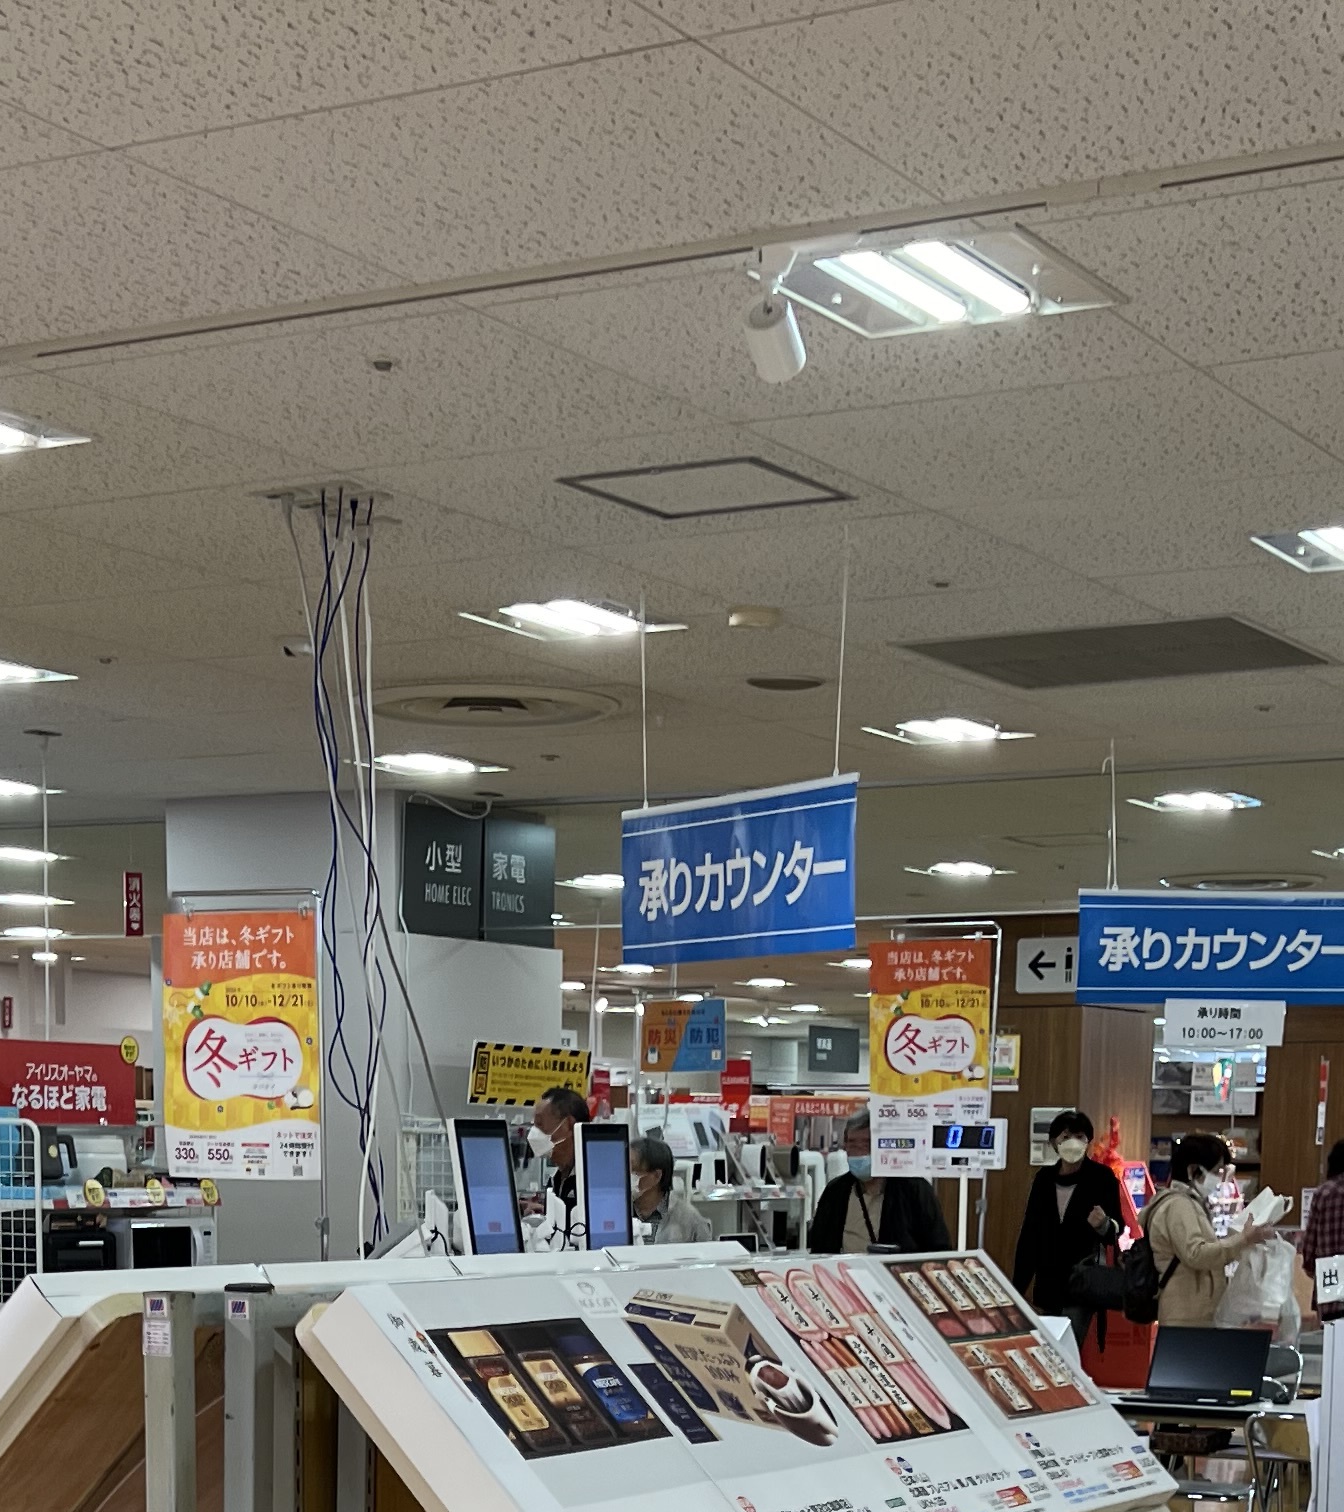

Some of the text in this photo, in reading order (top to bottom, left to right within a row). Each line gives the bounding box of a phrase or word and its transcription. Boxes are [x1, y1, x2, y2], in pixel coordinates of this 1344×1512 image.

[425, 840, 463, 874] 小型
[492, 852, 526, 884] 家電
[638, 839, 846, 922] 承りカウンター
[424, 882, 472, 907] HOME ELEC
[492, 891, 525, 914] TRONICS
[183, 925, 294, 947] 当店は、冬ギフト
[191, 950, 287, 970] 承り店舗です。
[887, 949, 975, 966] 当店は、冬ギフト
[894, 966, 967, 982] 承り店舗です。
[1196, 1006, 1242, 1020] 承り時間
[647, 1027, 677, 1046] 防災
[689, 1026, 721, 1046] 防犯
[11, 1084, 107, 1112] なるほど家電
